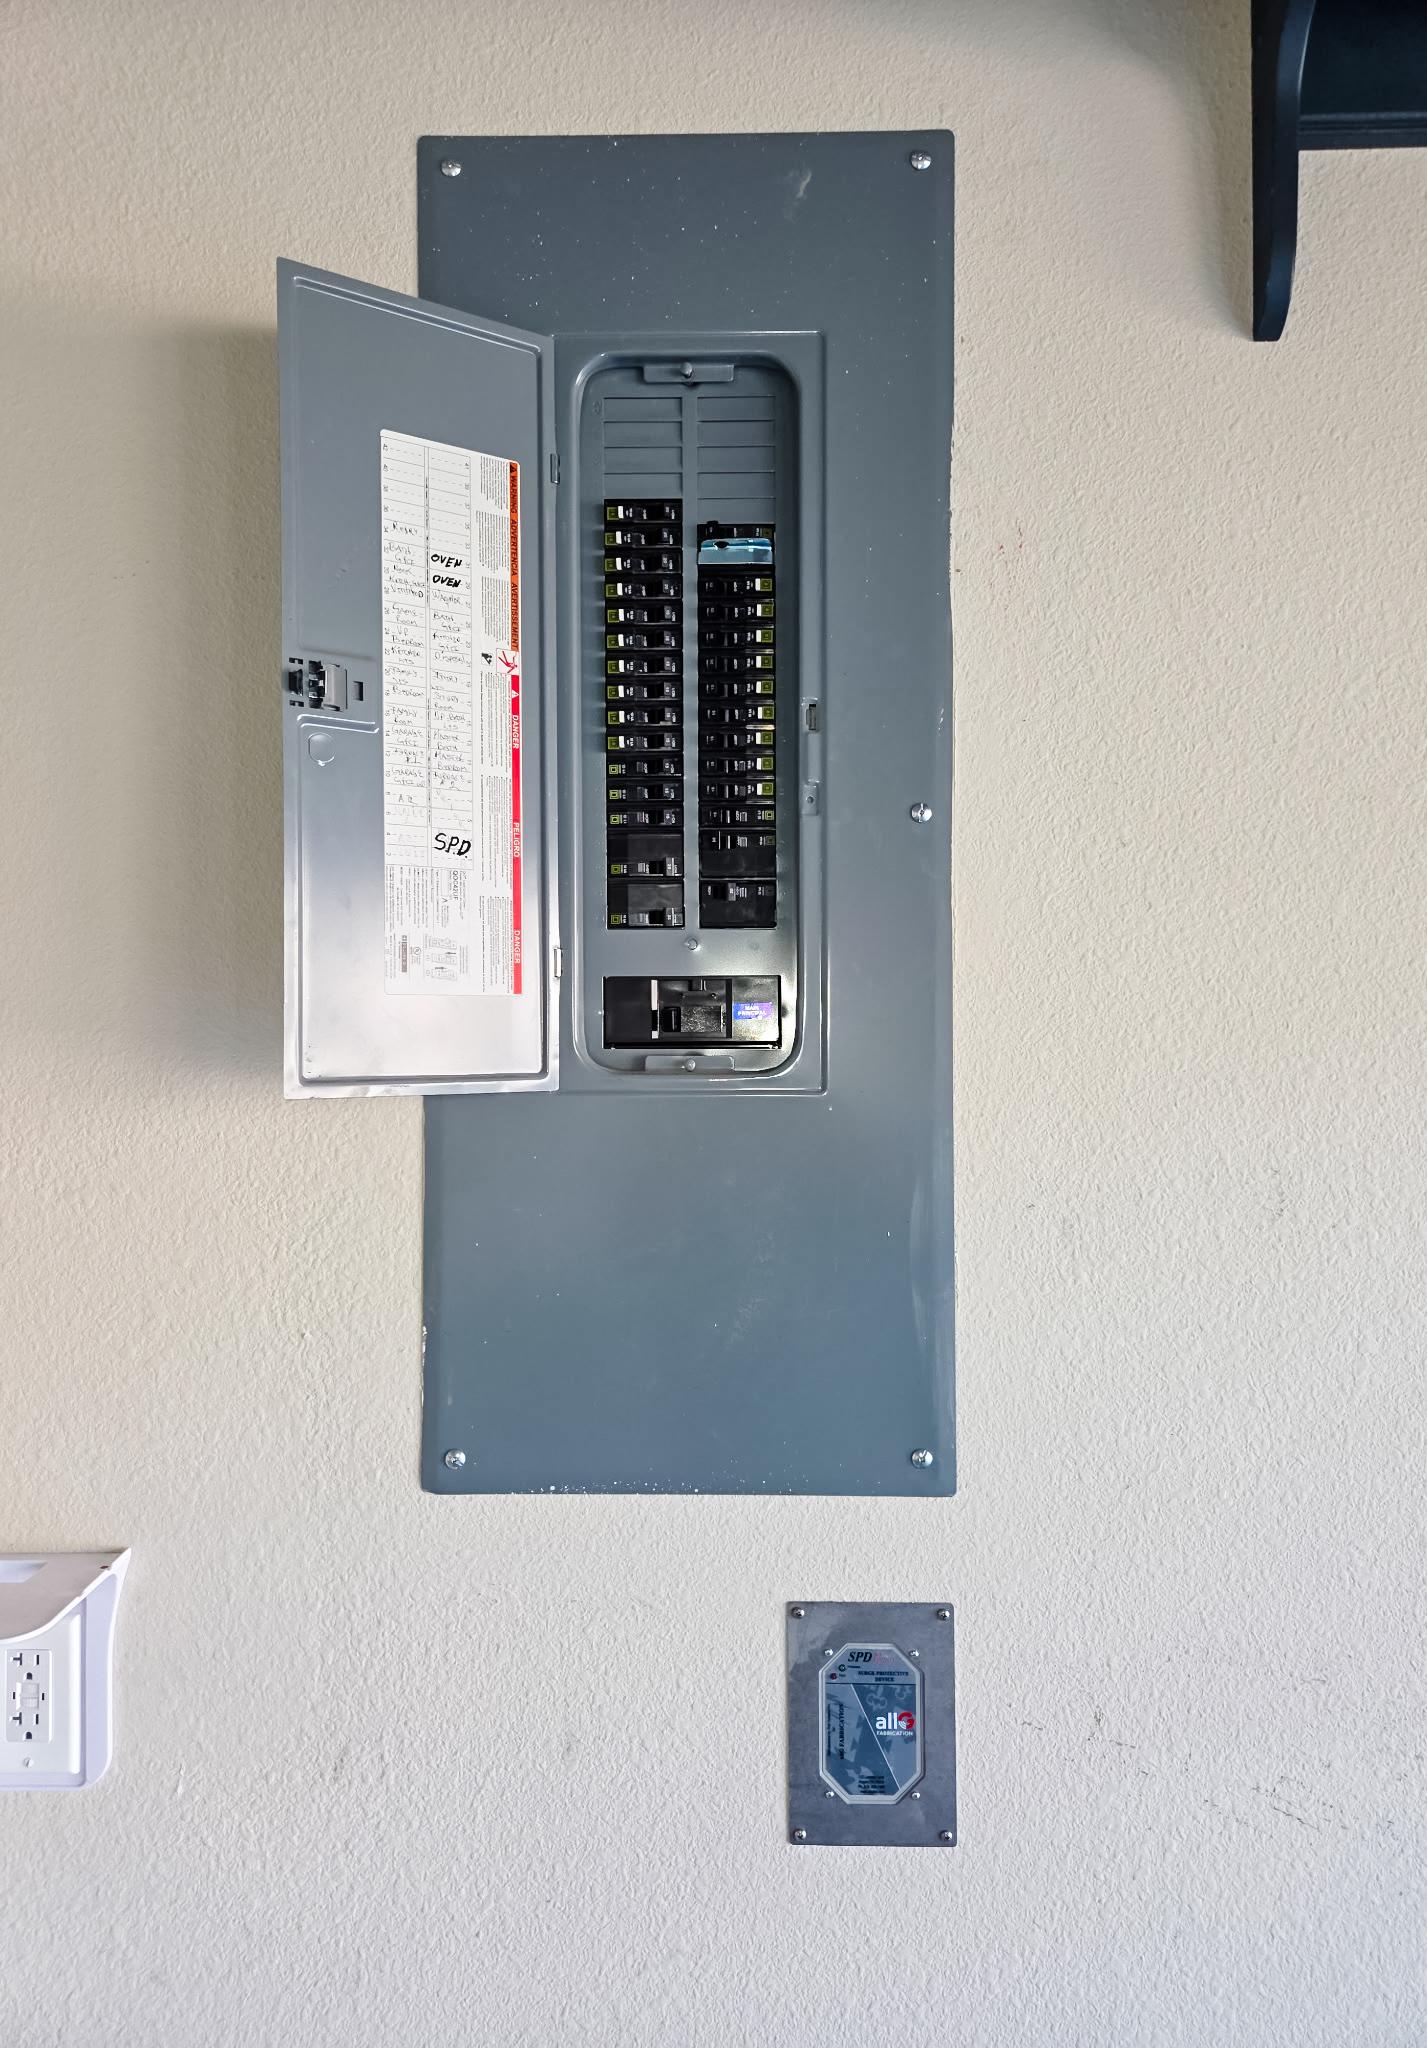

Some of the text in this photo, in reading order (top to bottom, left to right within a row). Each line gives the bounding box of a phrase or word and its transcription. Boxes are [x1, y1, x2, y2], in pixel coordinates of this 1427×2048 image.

[430, 553, 463, 568] OVEN
[510, 476, 519, 651] WARNING ADVERTENCIA AVERTISSEMENT
[432, 574, 462, 588] OVEN
[512, 714, 521, 964] DANGER PELIGRO DANGER
[847, 1651, 873, 1663] SPD
